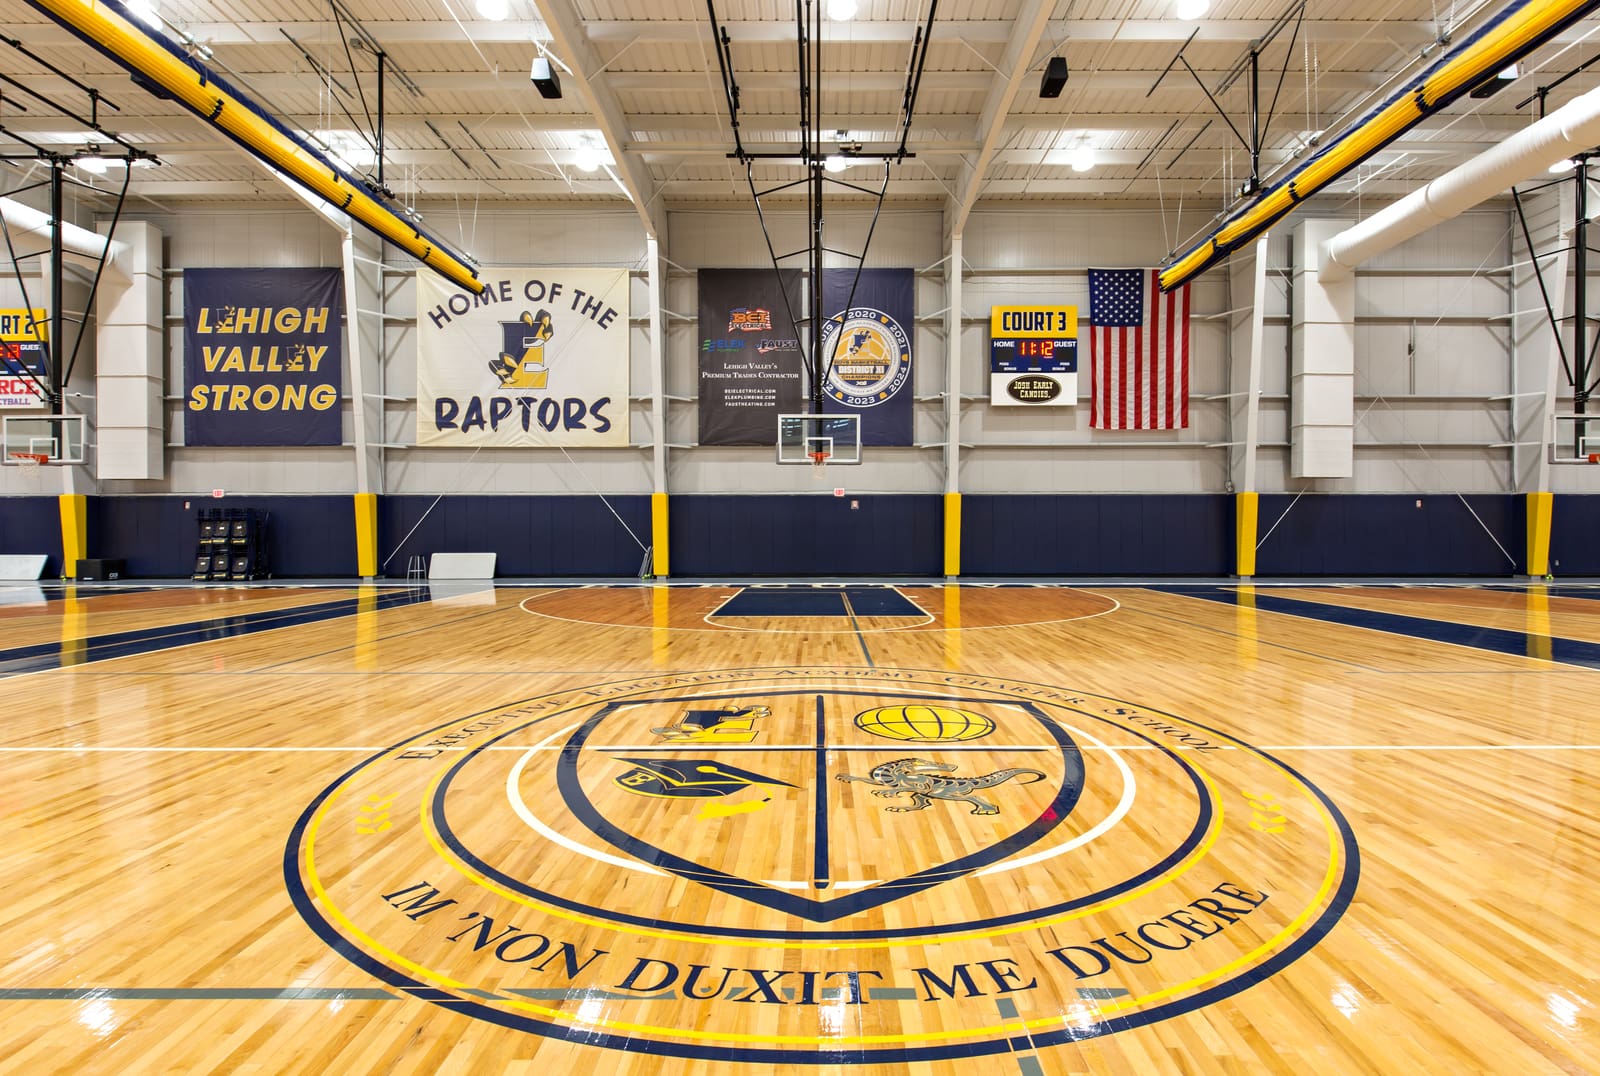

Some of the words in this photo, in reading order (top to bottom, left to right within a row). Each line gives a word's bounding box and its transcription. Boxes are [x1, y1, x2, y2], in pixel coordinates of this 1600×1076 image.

[427, 280, 513, 329] HOME
[524, 280, 563, 303] OF
[571, 289, 618, 330] THE
[847, 310, 876, 319] 2020
[197, 305, 329, 334] LEHIGH
[732, 312, 768, 323] BEI
[1003, 312, 1054, 331] COURT
[1058, 312, 1066, 331] 3
[761, 339, 798, 348] FAUST
[889, 324, 906, 348] 2021
[202, 344, 329, 372] VALLEY
[1020, 341, 1053, 356] 11:12
[888, 367, 907, 392] 2024
[1013, 381, 1031, 390] JOSH
[1033, 381, 1054, 389] EARLY
[189, 384, 337, 411] STRONG
[846, 396, 875, 405] 2023
[435, 396, 611, 433] RAPTORS
[394, 699, 571, 761] EXECUTIVE
[584, 671, 756, 698] EDUCATION
[944, 677, 1087, 705] CHARTER
[1104, 707, 1222, 754] SCHOOL
[381, 880, 458, 921] IM
[614, 957, 885, 1005] DUXIT
[911, 958, 1037, 1002] ME
[1045, 882, 1270, 980] DUCERE
